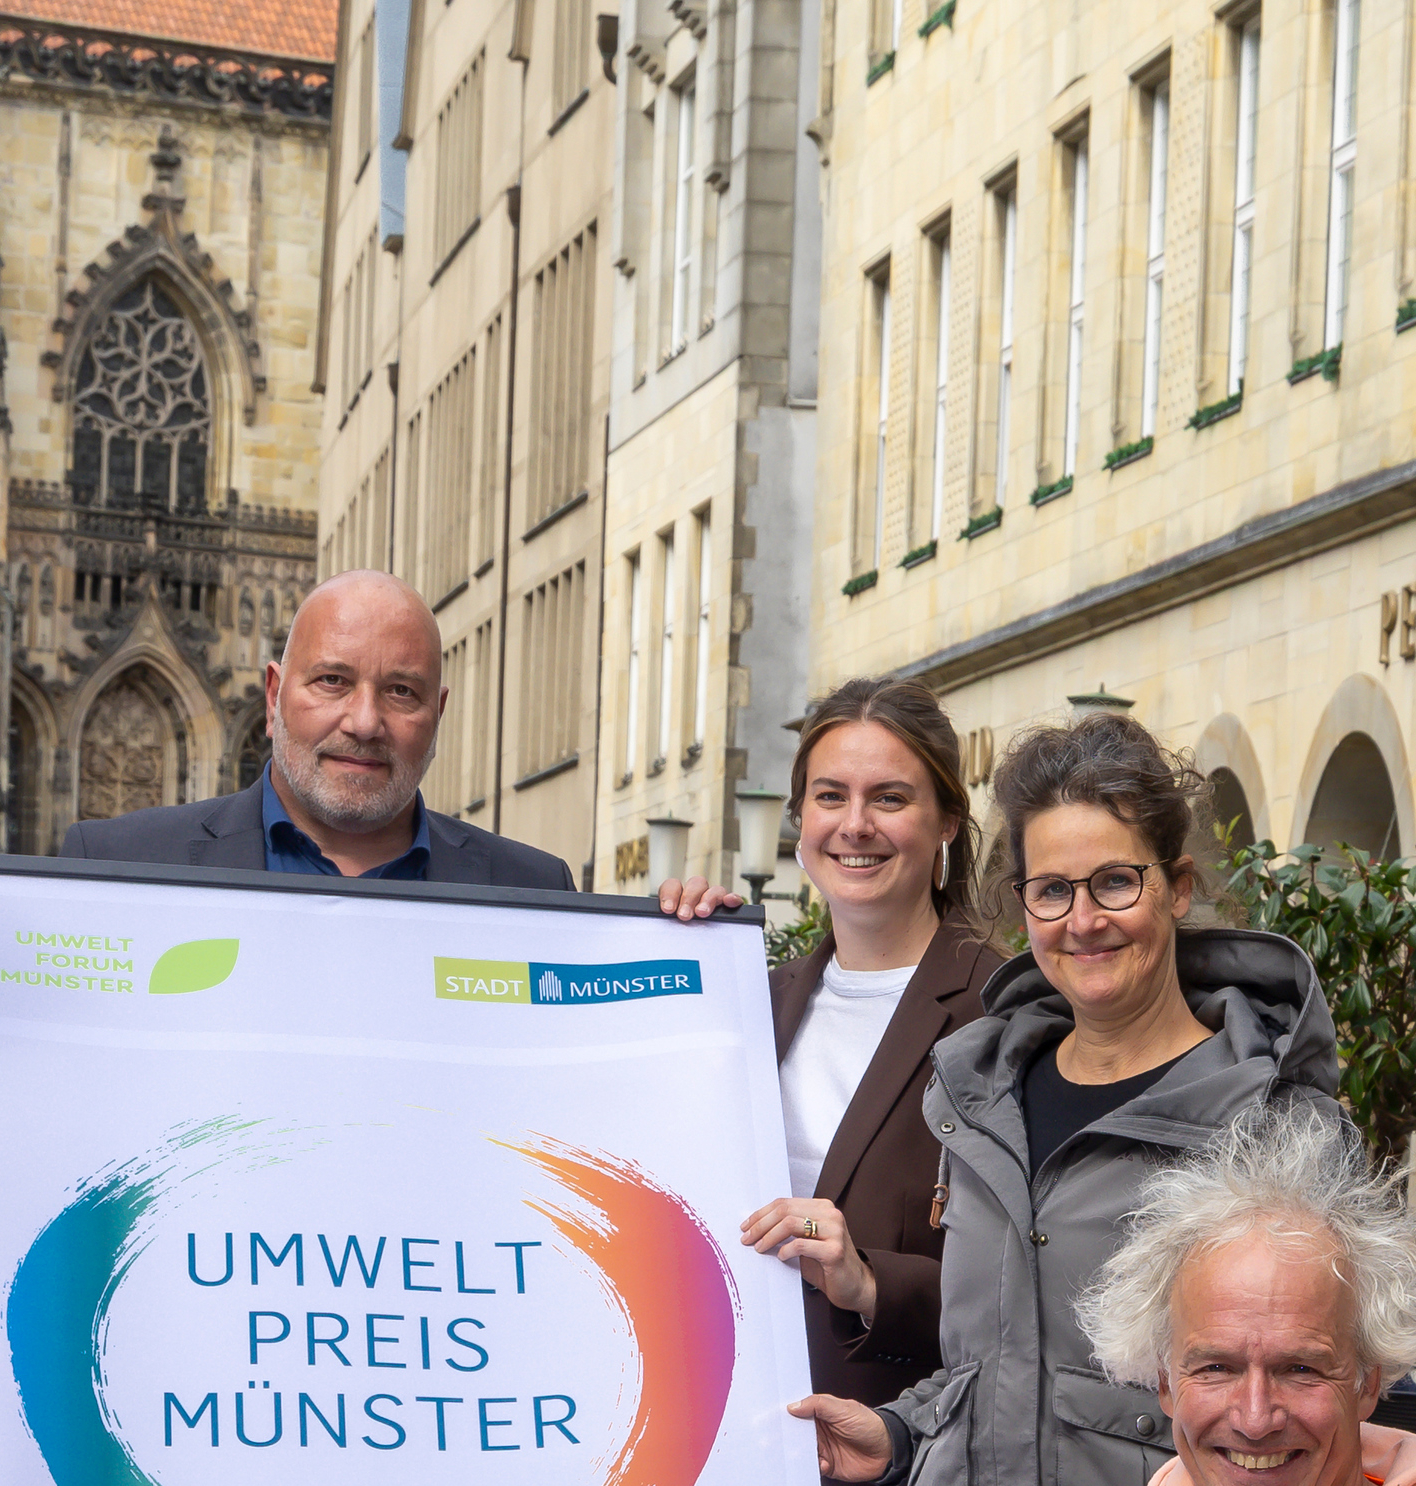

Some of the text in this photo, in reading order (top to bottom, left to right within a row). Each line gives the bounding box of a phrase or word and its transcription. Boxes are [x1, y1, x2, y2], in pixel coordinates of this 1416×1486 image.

[15, 930, 134, 952] UMWELT
[35, 951, 134, 973] FORUM
[0, 968, 135, 994] MÜNSTER
[445, 973, 691, 998] STADT MÜNSTER
[186, 1231, 543, 1295] UMWELT
[248, 1310, 490, 1373] PREIS
[162, 1380, 582, 1452] MÜNSTER
